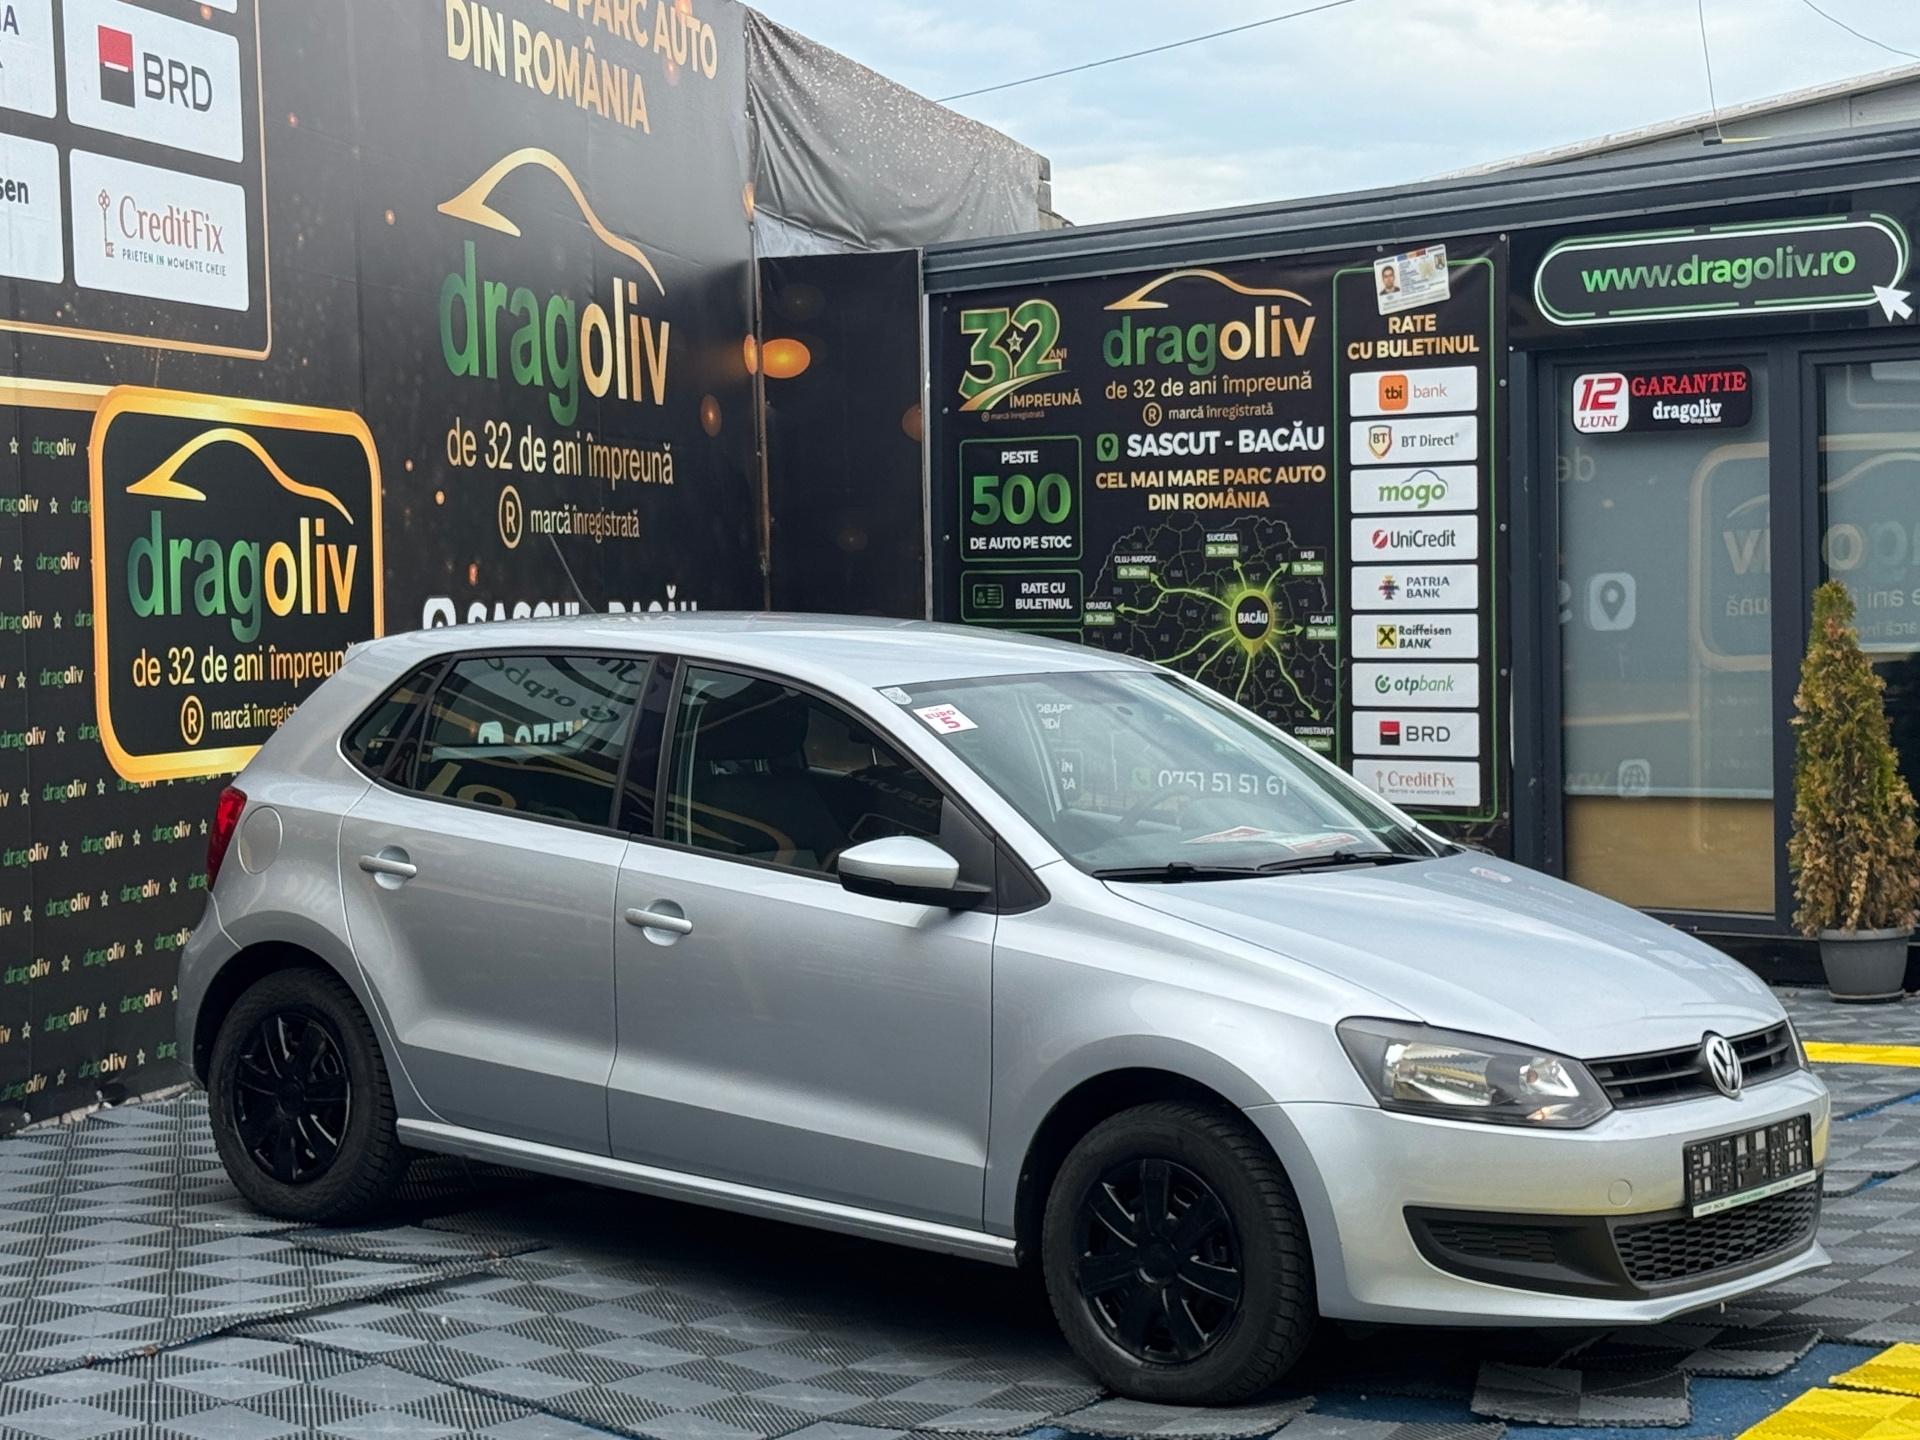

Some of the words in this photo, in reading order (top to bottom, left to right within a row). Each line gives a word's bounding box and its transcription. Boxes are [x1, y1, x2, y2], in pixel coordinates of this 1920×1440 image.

[653, 0, 718, 79] AUTO
[447, 0, 506, 77] DIN
[512, 19, 651, 135] ROMÂNIA
[143, 52, 213, 112] BRD
[119, 195, 224, 255] CreditFix
[122, 248, 154, 264] PRIETEN
[156, 254, 165, 266] IN
[167, 257, 203, 273] MOMENTE
[206, 263, 227, 277] CHEIE
[1581, 245, 1857, 294] www.dragoliv.ro
[440, 239, 670, 427] dragoliv
[1388, 313, 1437, 335] RATE
[958, 299, 1062, 399] 32
[1103, 304, 1316, 376] dragoliv
[1347, 341, 1373, 360] CU
[1376, 335, 1480, 359] BULETINUL
[1048, 348, 1067, 361] ANI
[1106, 380, 1128, 400] de
[1133, 378, 1156, 398] 32
[1161, 377, 1184, 397] de
[1190, 375, 1217, 395] ani
[1223, 371, 1313, 396] împreună
[1384, 384, 1403, 400] tbi
[1413, 383, 1448, 399] bank
[1579, 377, 1623, 411] 12
[1631, 371, 1747, 396] GARANTIE
[1009, 388, 1082, 409] ÎMPREUNĂ
[1168, 405, 1204, 419] marcă
[1206, 403, 1274, 421] înregistrată
[1580, 415, 1619, 428] LUNI
[1652, 398, 1722, 424] dragoliv
[32, 436, 77, 459] dragoliv
[1127, 430, 1221, 458] SASCUT
[1239, 421, 1325, 453] BACĂU
[1373, 432, 1388, 444] BT
[1401, 435, 1417, 448] BT
[447, 416, 477, 467] de
[484, 419, 513, 470] 32
[519, 425, 546, 474] de
[553, 431, 582, 477] ani
[587, 432, 674, 491] împreună
[1001, 450, 1039, 465] PESTE
[1096, 471, 1128, 489] CEL
[1130, 469, 1164, 487] MAI
[1168, 467, 1220, 486] MARE
[1223, 466, 1272, 485] PARC
[1275, 465, 1326, 484] AUTO
[0, 494, 39, 517] ragoliv
[970, 473, 1072, 525] 500
[1148, 492, 1181, 511] DIN
[1183, 488, 1270, 509] ROMÂNIA
[1378, 483, 1446, 509] mogo
[530, 504, 572, 536] marcă
[573, 505, 641, 544] înregistrată
[970, 537, 987, 550] DE
[989, 536, 1021, 549] AUTO
[1023, 536, 1039, 549] PE
[1041, 535, 1072, 549] STOC
[1390, 528, 1456, 549] UniCredit
[36, 552, 81, 575] dragoliv
[127, 510, 358, 643] dragoliv
[1021, 582, 1048, 594] RATE
[1050, 582, 1065, 593] CU
[1406, 576, 1450, 587] PATRIA
[1015, 598, 1073, 610] BULETINUL
[1406, 588, 1440, 599] BANK
[1237, 610, 1268, 624] BACĂU
[1399, 625, 1452, 636] Raiffeisen
[1399, 638, 1431, 649] BANK
[39, 665, 84, 689] dragoliv
[133, 649, 161, 688] de
[168, 646, 195, 686] 32
[201, 645, 228, 684] de
[234, 645, 263, 682] ani
[270, 643, 354, 688] împreun
[1394, 674, 1454, 695] otpbank
[211, 704, 251, 732] marcă
[940, 716, 961, 729] 5
[0, 726, 46, 751] dragoliv
[1406, 726, 1450, 742] BRD
[1211, 772, 1232, 792] 51
[1238, 774, 1259, 795] 51
[1266, 775, 1287, 796] 61
[1388, 769, 1455, 788] CreditFix
[42, 779, 87, 803] dragoliv
[81, 831, 124, 854] dragoliv
[152, 820, 191, 844] dragoliv
[3, 842, 49, 868] dragoliv
[120, 879, 160, 903] dragoliv
[45, 892, 91, 917] dragoliv
[83, 942, 126, 967] dragoliv
[4, 958, 51, 985] dragoliv
[119, 987, 163, 1013] dragoliv
[44, 1005, 89, 1032] dragoliv
